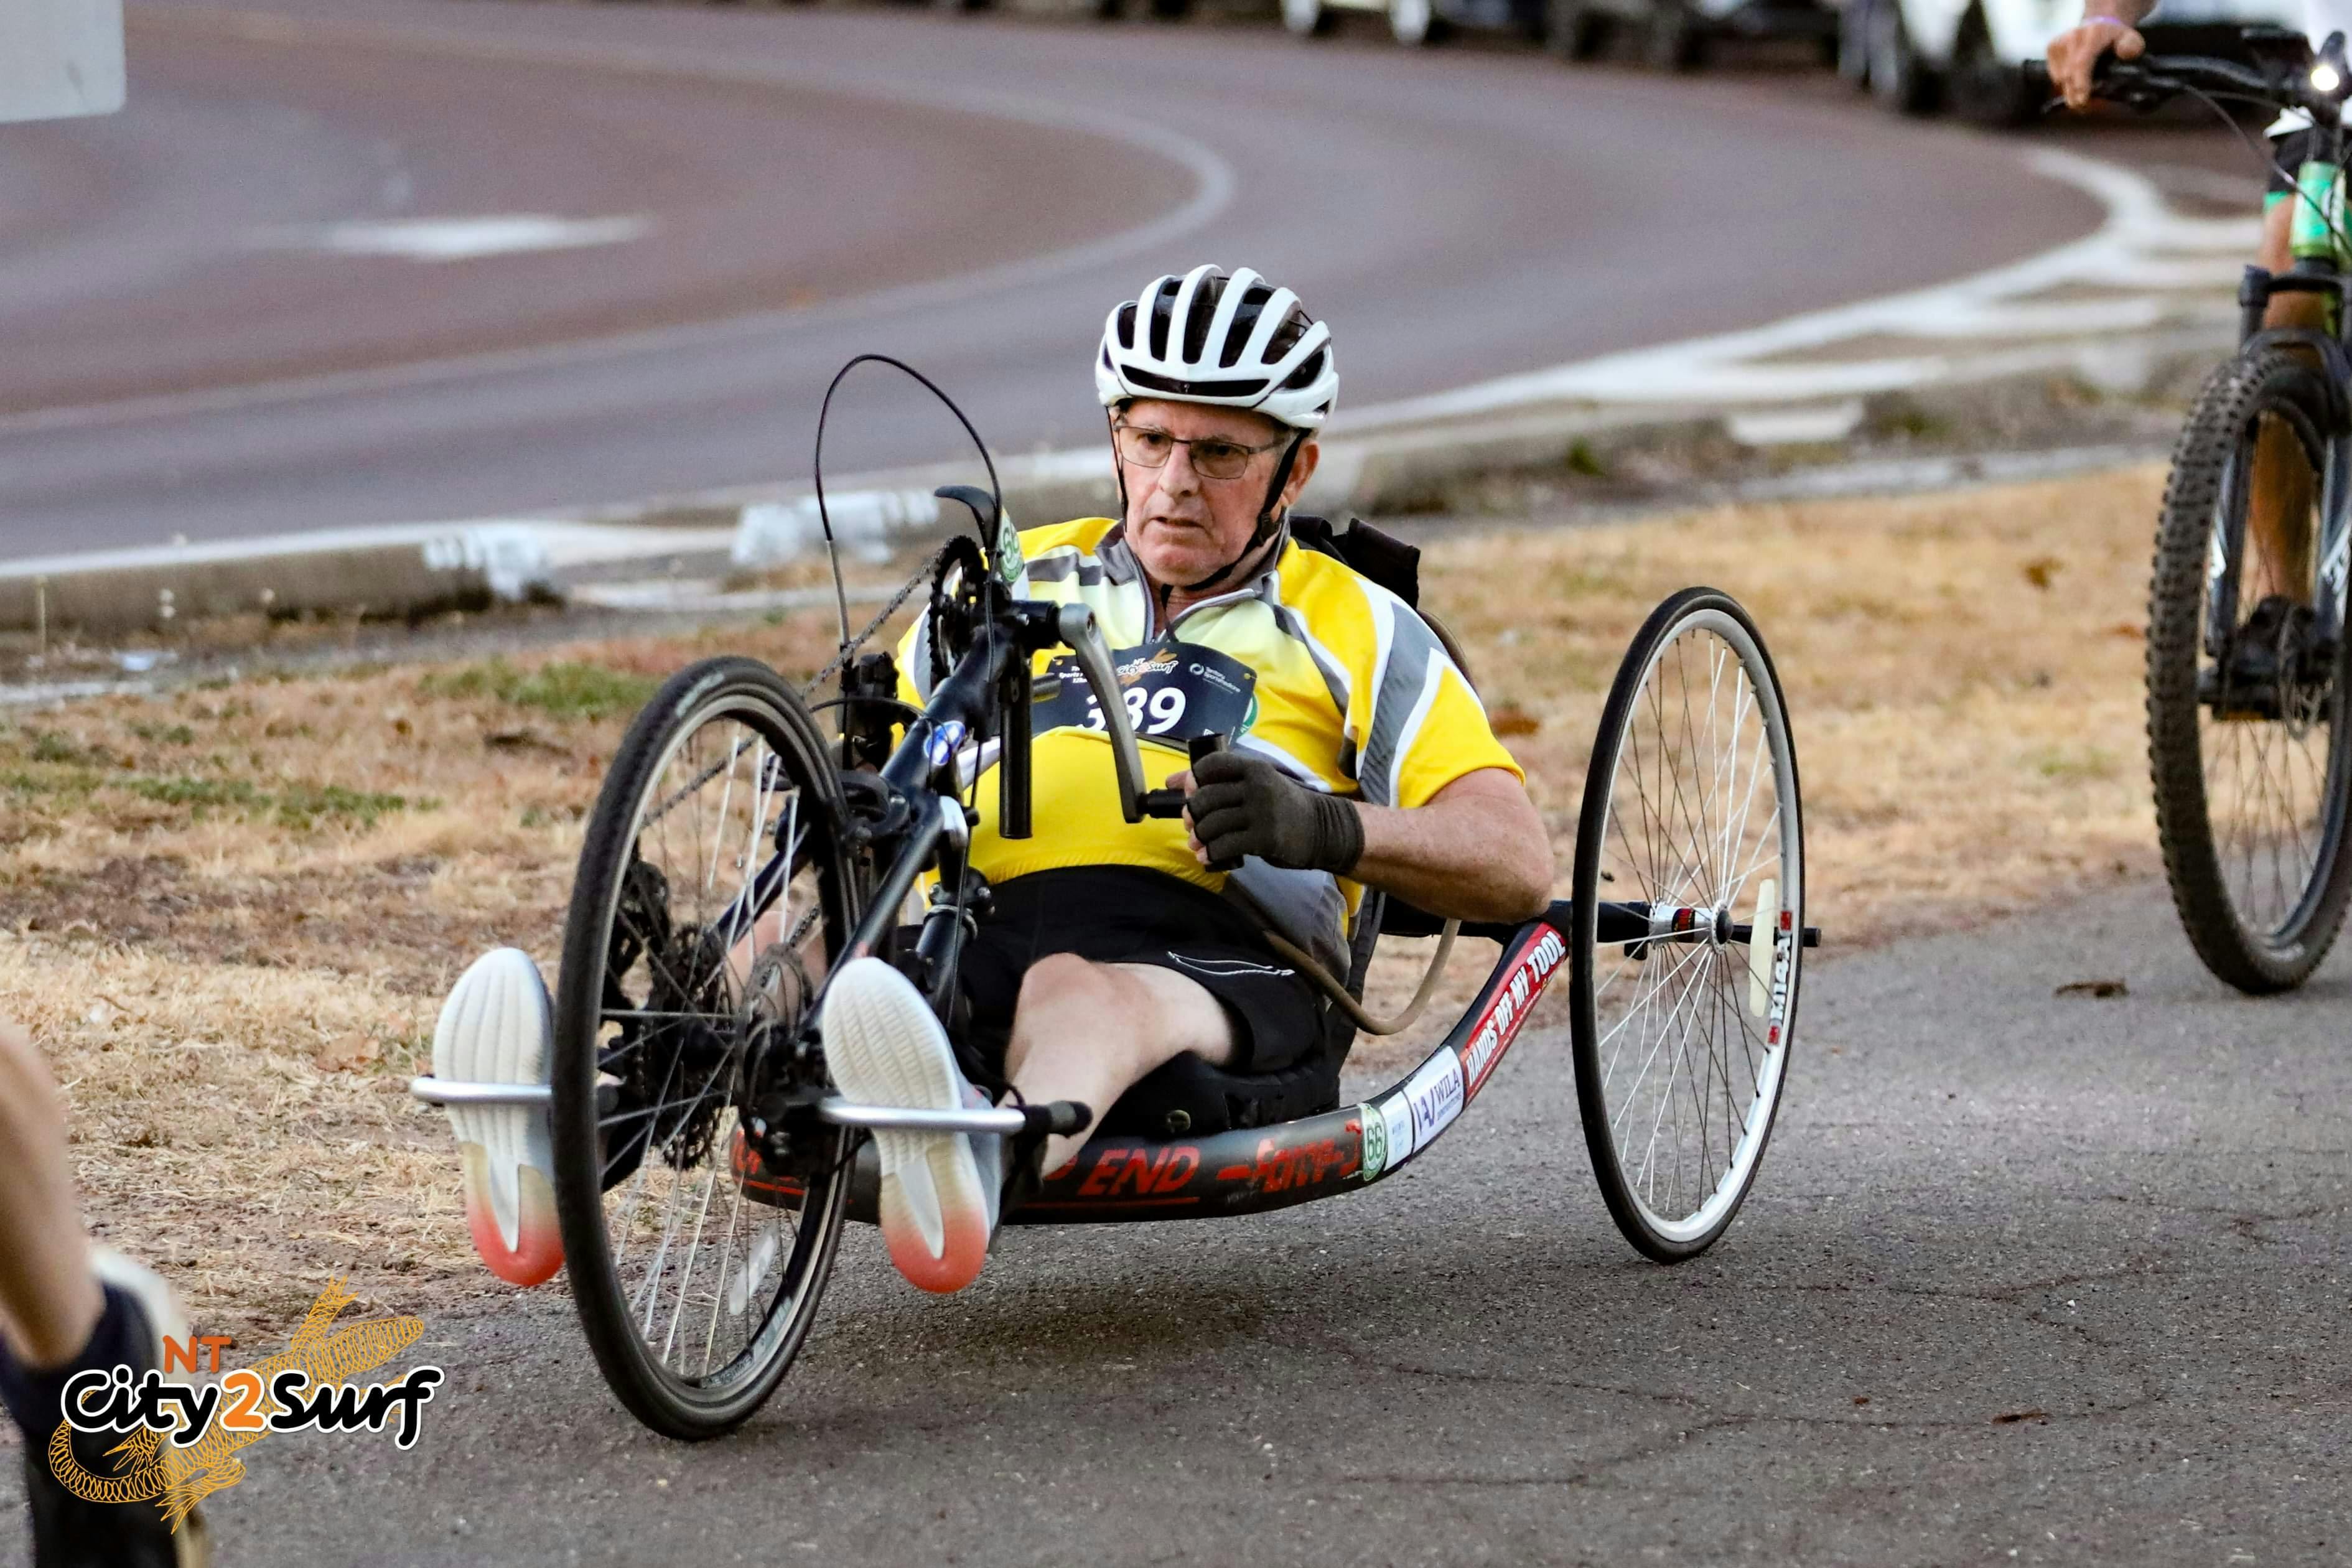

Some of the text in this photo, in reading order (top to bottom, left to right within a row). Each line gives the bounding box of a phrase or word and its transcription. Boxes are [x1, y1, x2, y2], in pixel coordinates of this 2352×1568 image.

[1466, 930, 1566, 1086] HANDS OFF MY TOOL
[1366, 1122, 1383, 1162] 66
[1077, 1146, 1200, 1196] END
